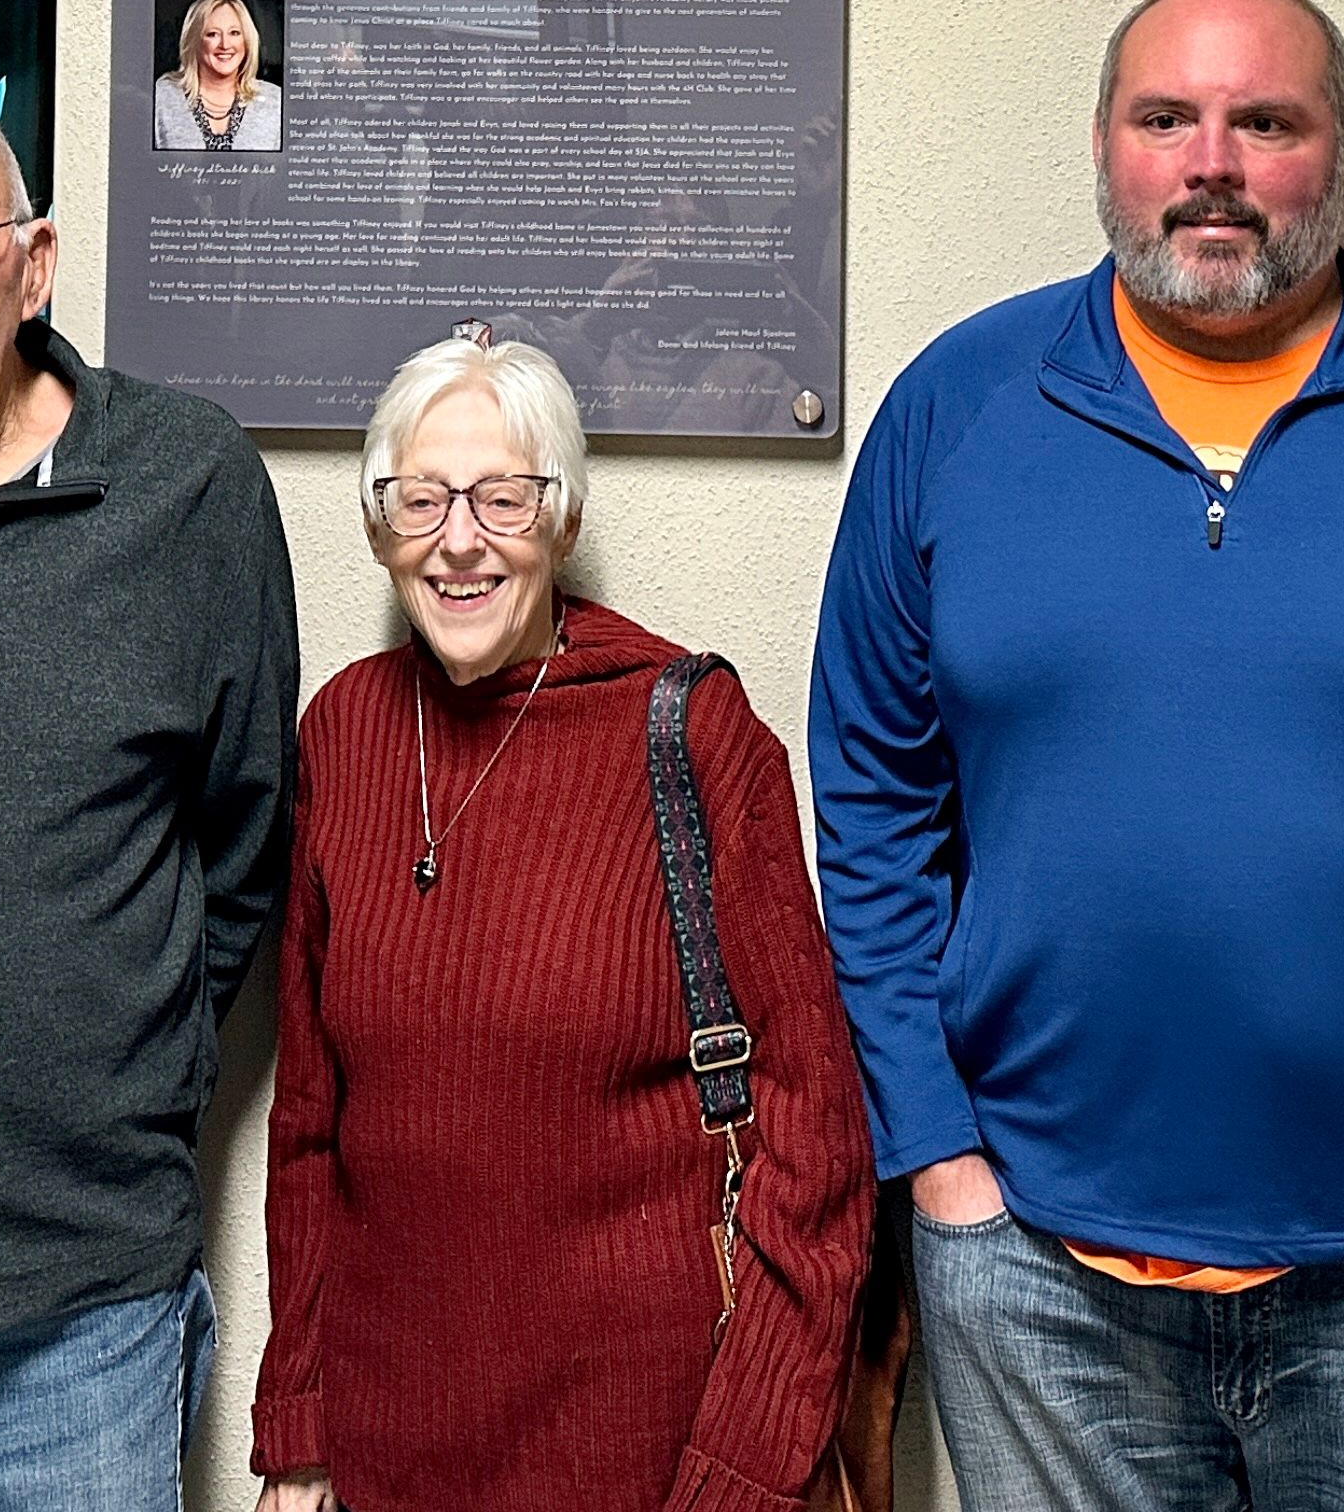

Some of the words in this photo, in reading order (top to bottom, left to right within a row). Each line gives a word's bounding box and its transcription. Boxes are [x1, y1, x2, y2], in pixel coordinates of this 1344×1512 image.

[487, 5, 510, 15] family
[351, 16, 369, 25] Jesus
[371, 16, 394, 25] Christ
[413, 17, 436, 27] place
[495, 43, 521, 52] friends,
[616, 44, 637, 53] loved
[758, 58, 778, 67] loved
[413, 67, 436, 77] family
[627, 83, 648, 91] hours
[537, 94, 563, 105] helped
[620, 95, 638, 106] good
[289, 117, 307, 125] Most
[519, 120, 539, 128] loved
[583, 146, 606, 155] school
[427, 157, 447, 168] place
[642, 160, 660, 168] Jesus
[363, 169, 384, 178] loved
[357, 182, 372, 190] love
[288, 194, 311, 202] school
[272, 218, 294, 227] books
[187, 230, 208, 239] books
[229, 282, 247, 290] lived
[658, 289, 676, 299] good
[249, 295, 273, 305] library
[767, 342, 795, 353] Tiffiney
